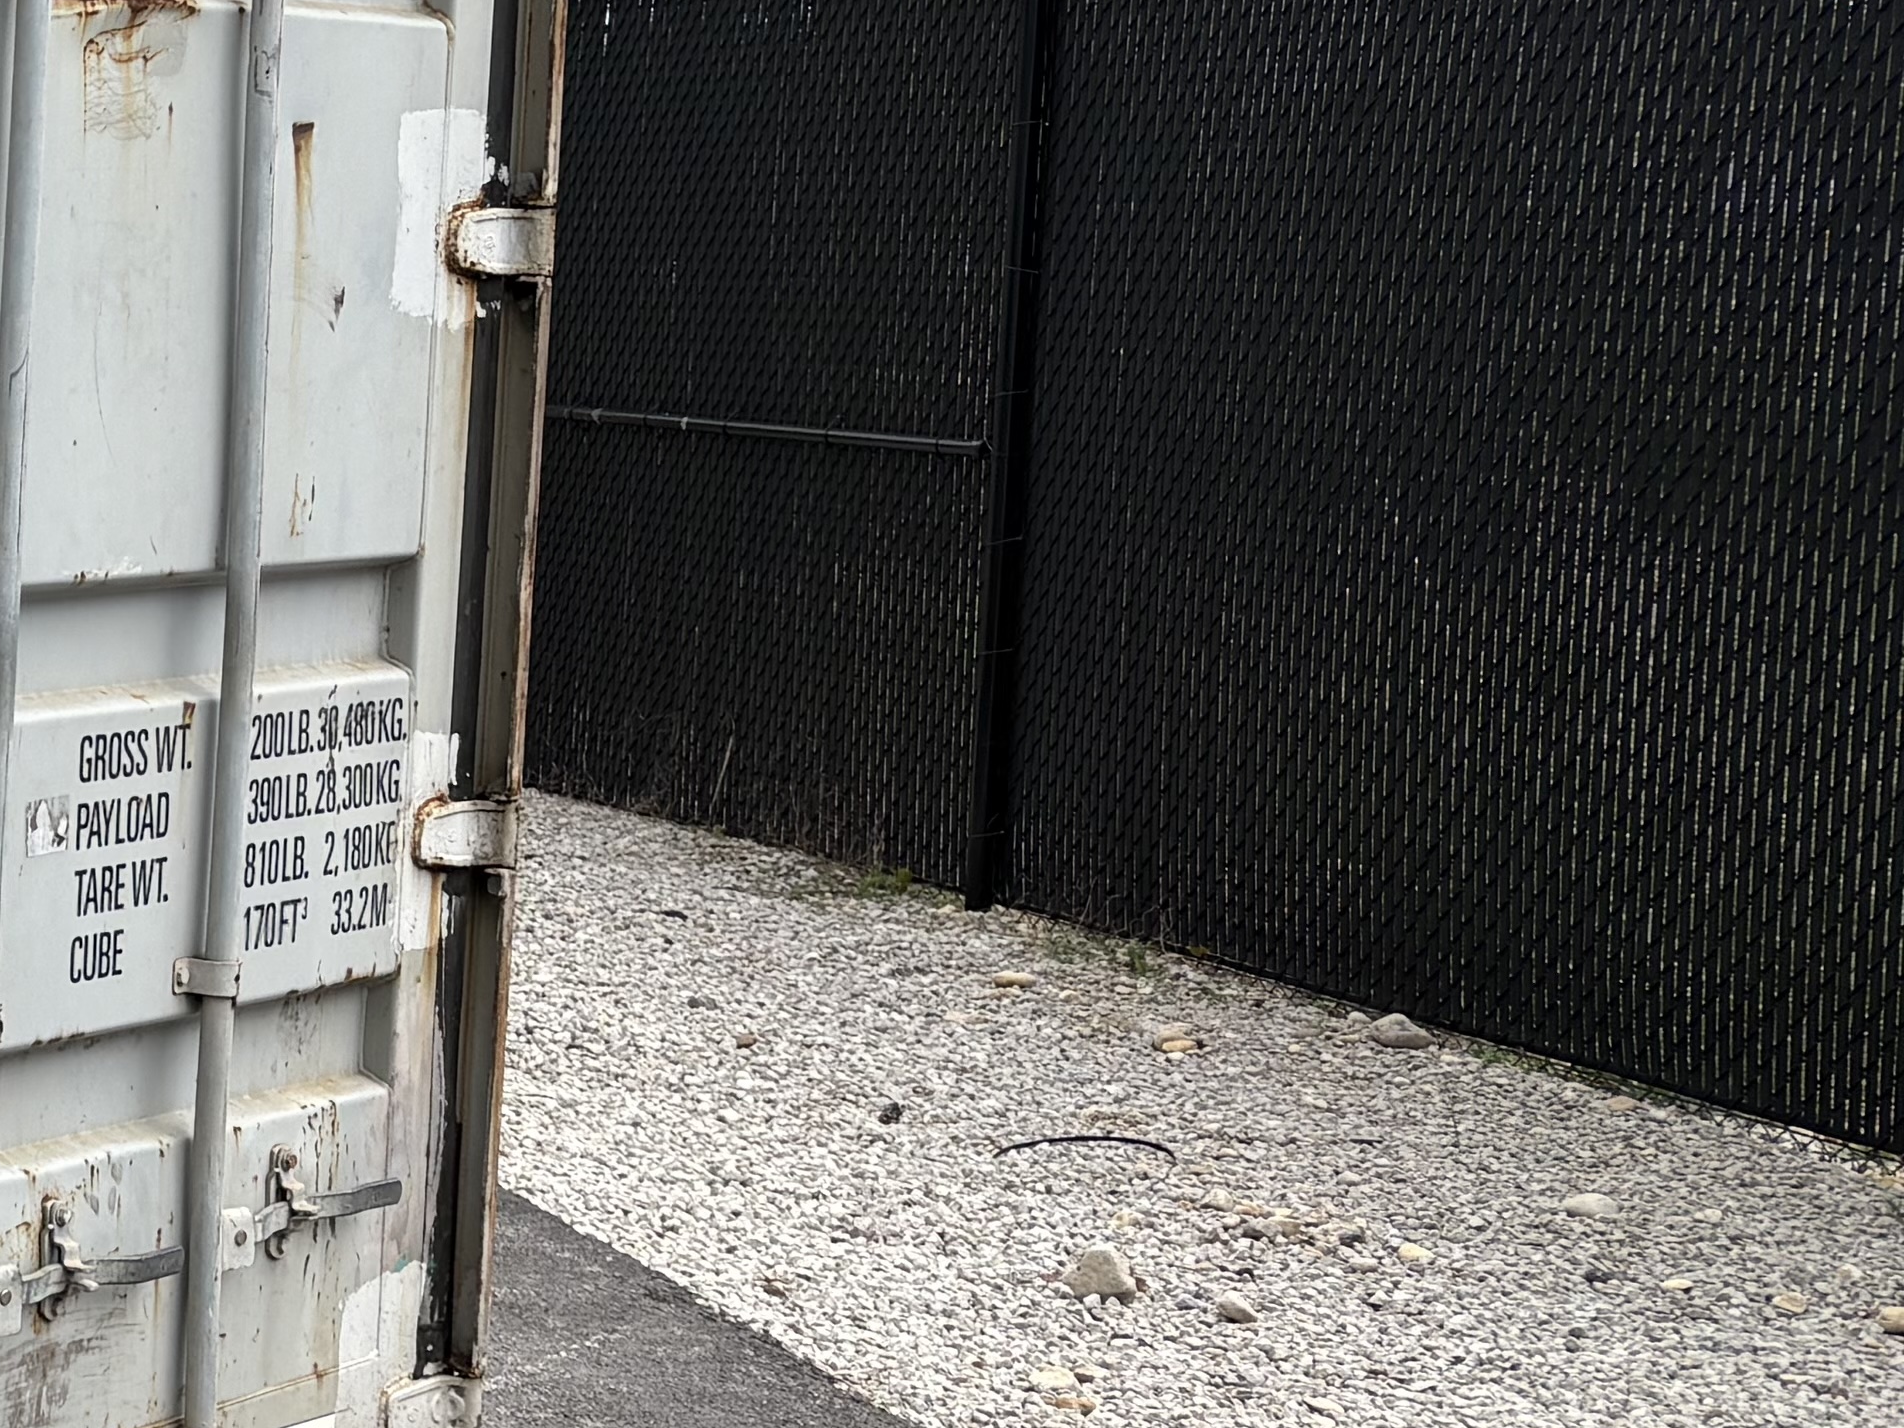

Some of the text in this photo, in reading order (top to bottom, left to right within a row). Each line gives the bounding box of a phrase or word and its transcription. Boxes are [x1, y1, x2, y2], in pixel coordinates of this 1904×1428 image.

[79, 728, 150, 783] GROSS
[155, 723, 193, 774] WT.
[76, 792, 170, 851] PAYLOAD
[75, 860, 127, 918] TARE
[132, 856, 169, 908] WT.
[70, 928, 126, 984] CUBE
